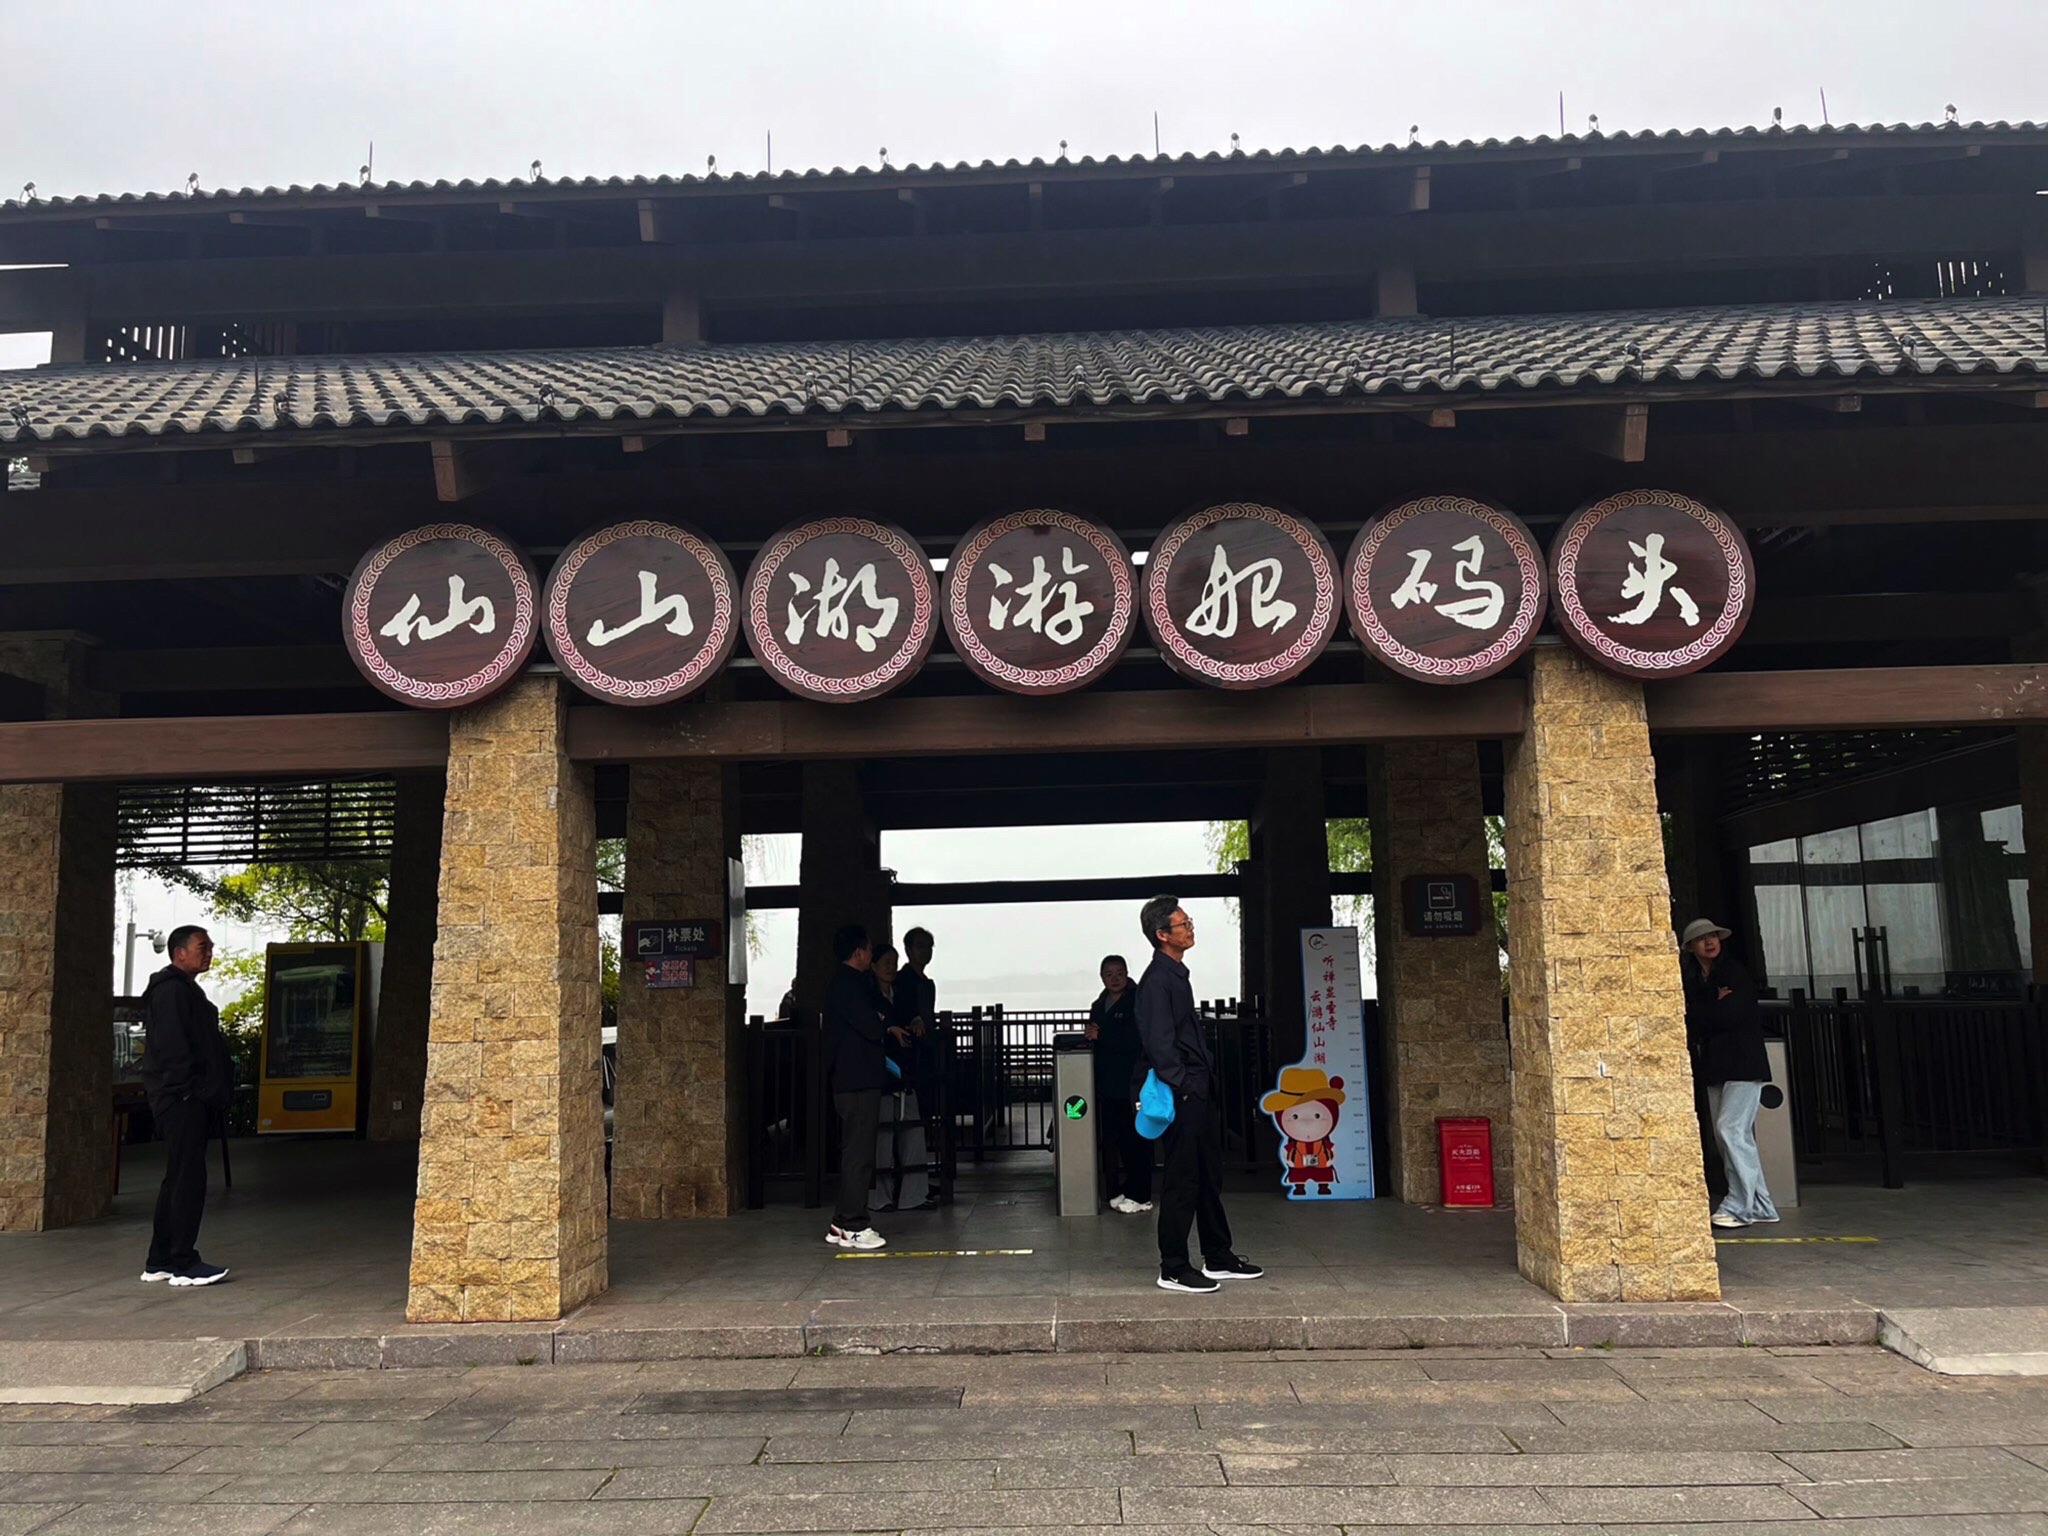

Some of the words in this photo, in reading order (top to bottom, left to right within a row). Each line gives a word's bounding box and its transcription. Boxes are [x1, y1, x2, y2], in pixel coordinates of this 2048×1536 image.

[667, 927, 705, 943] 补票处
[1309, 989, 1327, 1065] 云游仙山湖
